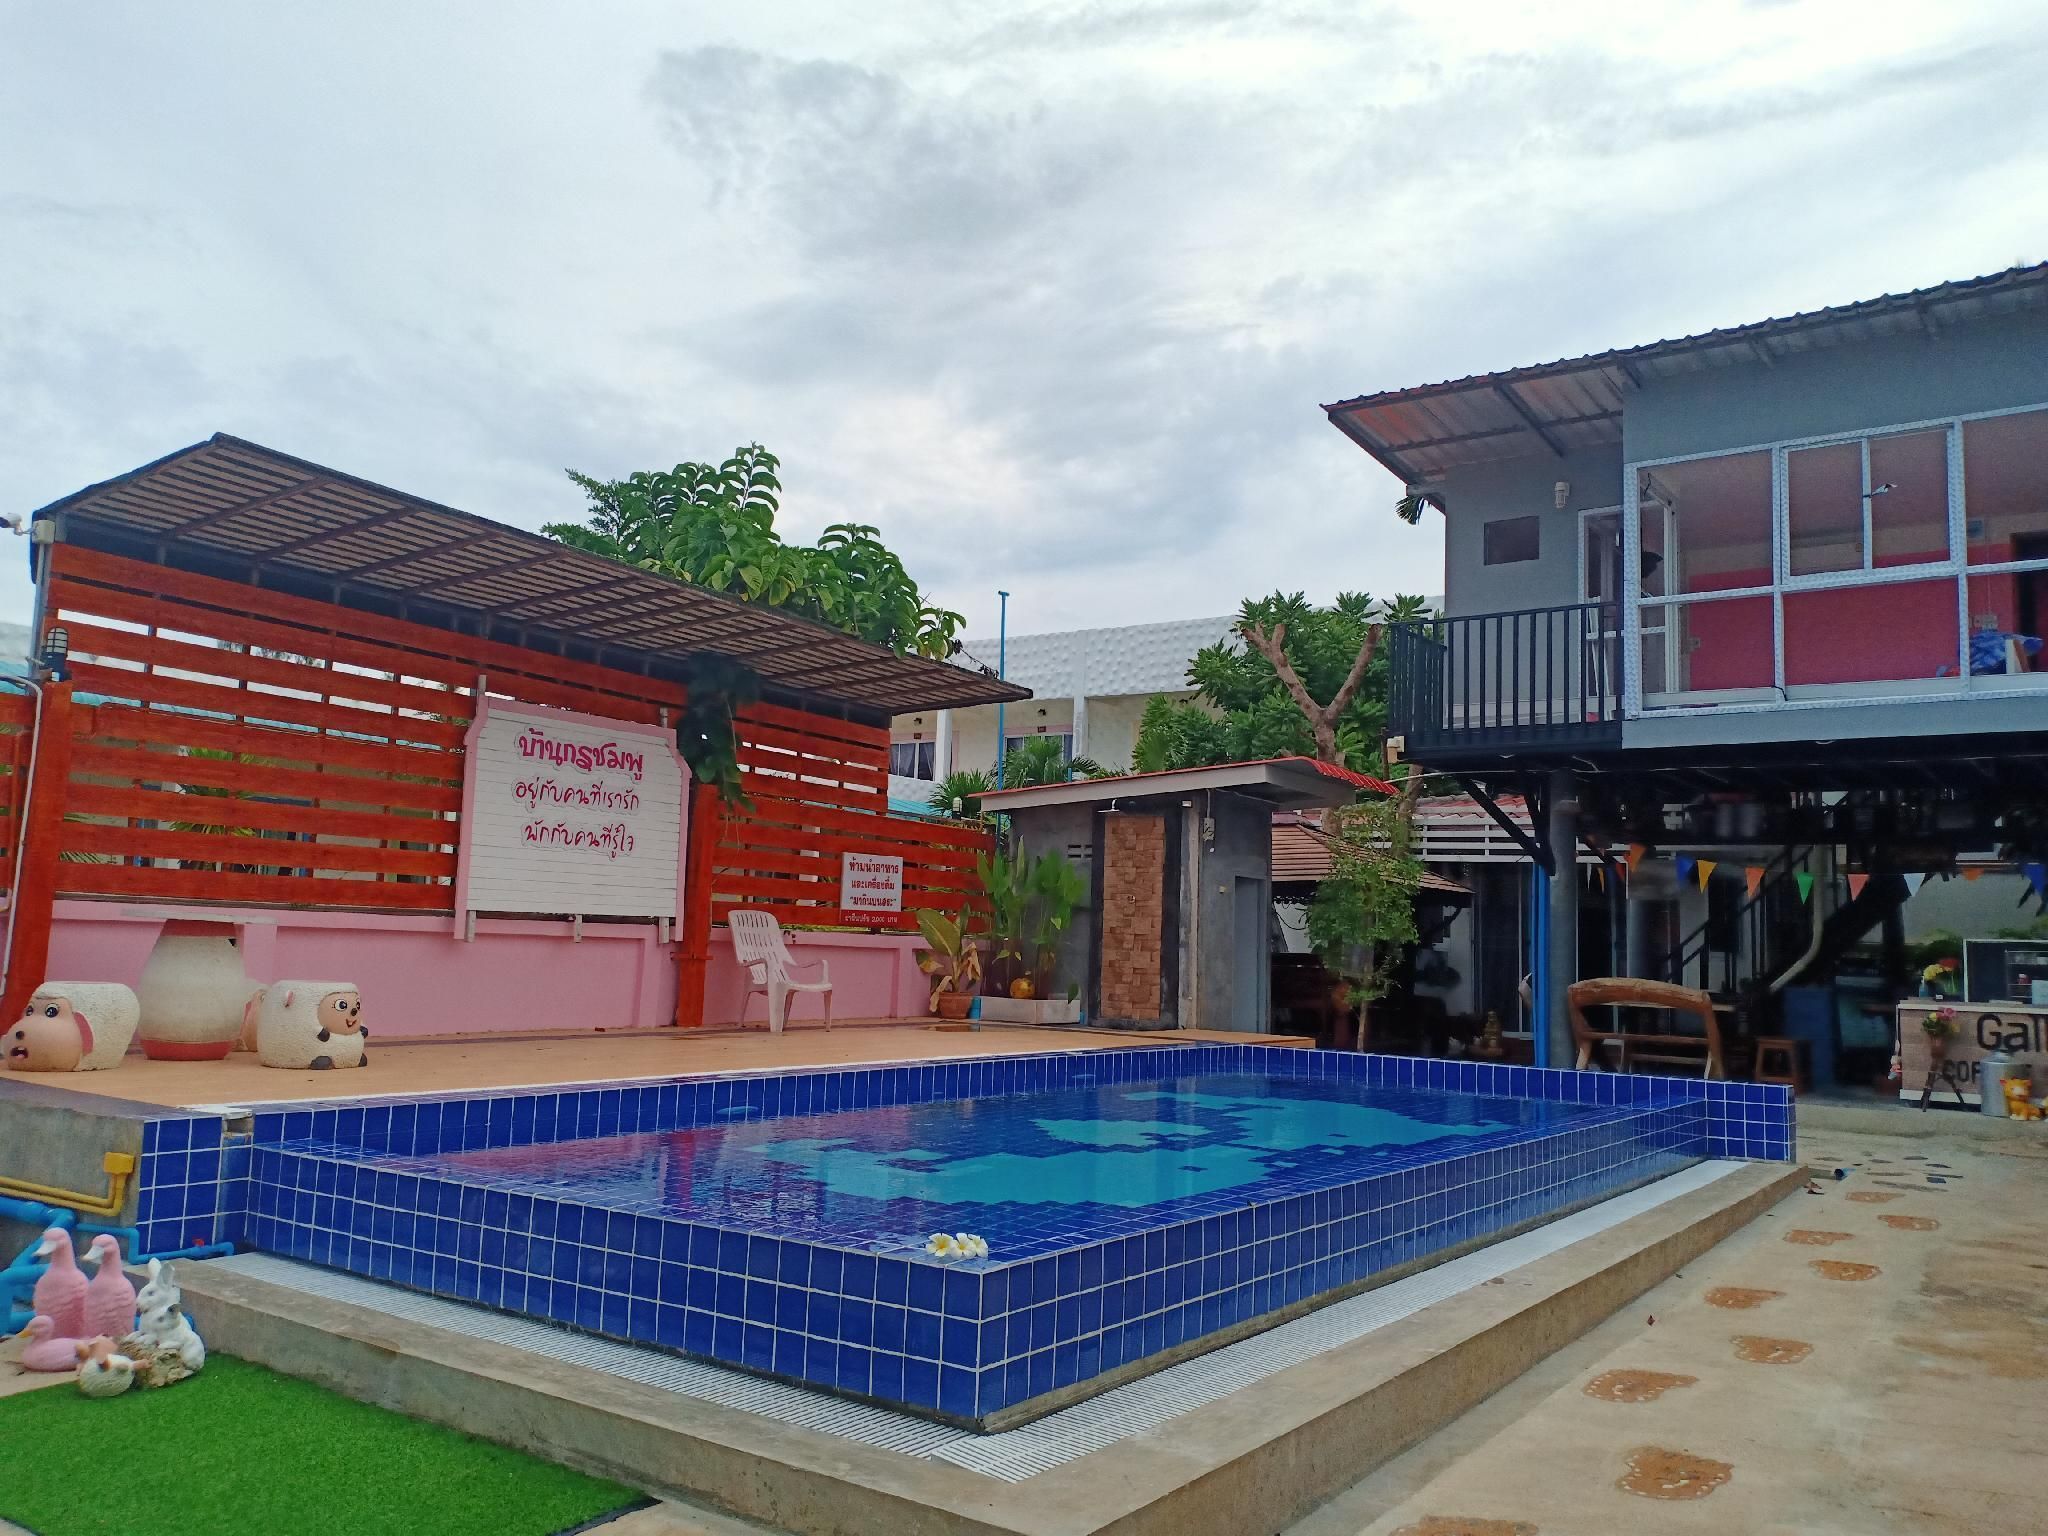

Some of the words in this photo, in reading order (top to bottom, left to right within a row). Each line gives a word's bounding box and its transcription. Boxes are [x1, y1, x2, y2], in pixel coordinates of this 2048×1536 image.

[516, 777, 639, 810] อยู่กับคนที่เรารัก
